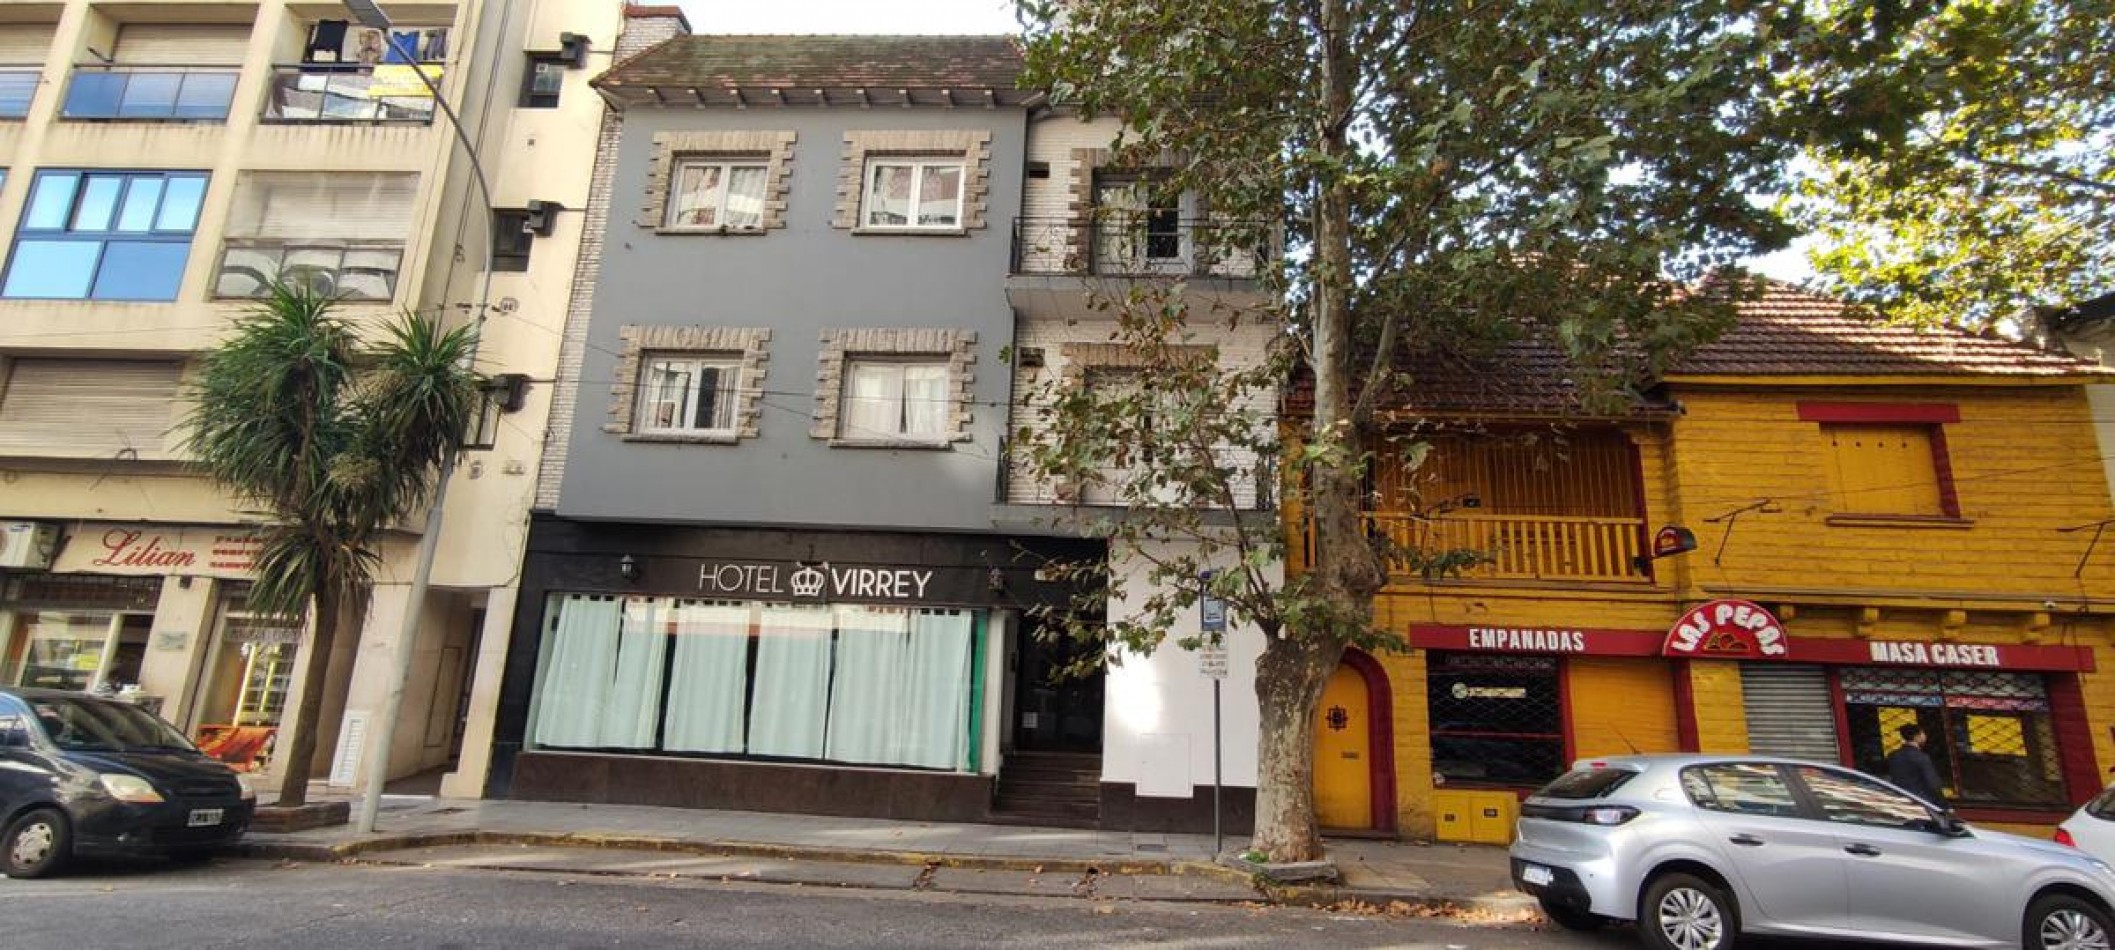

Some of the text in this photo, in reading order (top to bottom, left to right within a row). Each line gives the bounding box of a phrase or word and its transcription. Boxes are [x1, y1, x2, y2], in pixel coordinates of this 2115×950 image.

[93, 528, 195, 566] Lilian
[699, 563, 933, 598] HOTEL VIRREY
[1469, 628, 1585, 652] EMPANADAS
[1671, 603, 1785, 655] LAS PEPAS
[1870, 640, 2000, 666] MASA CASER
